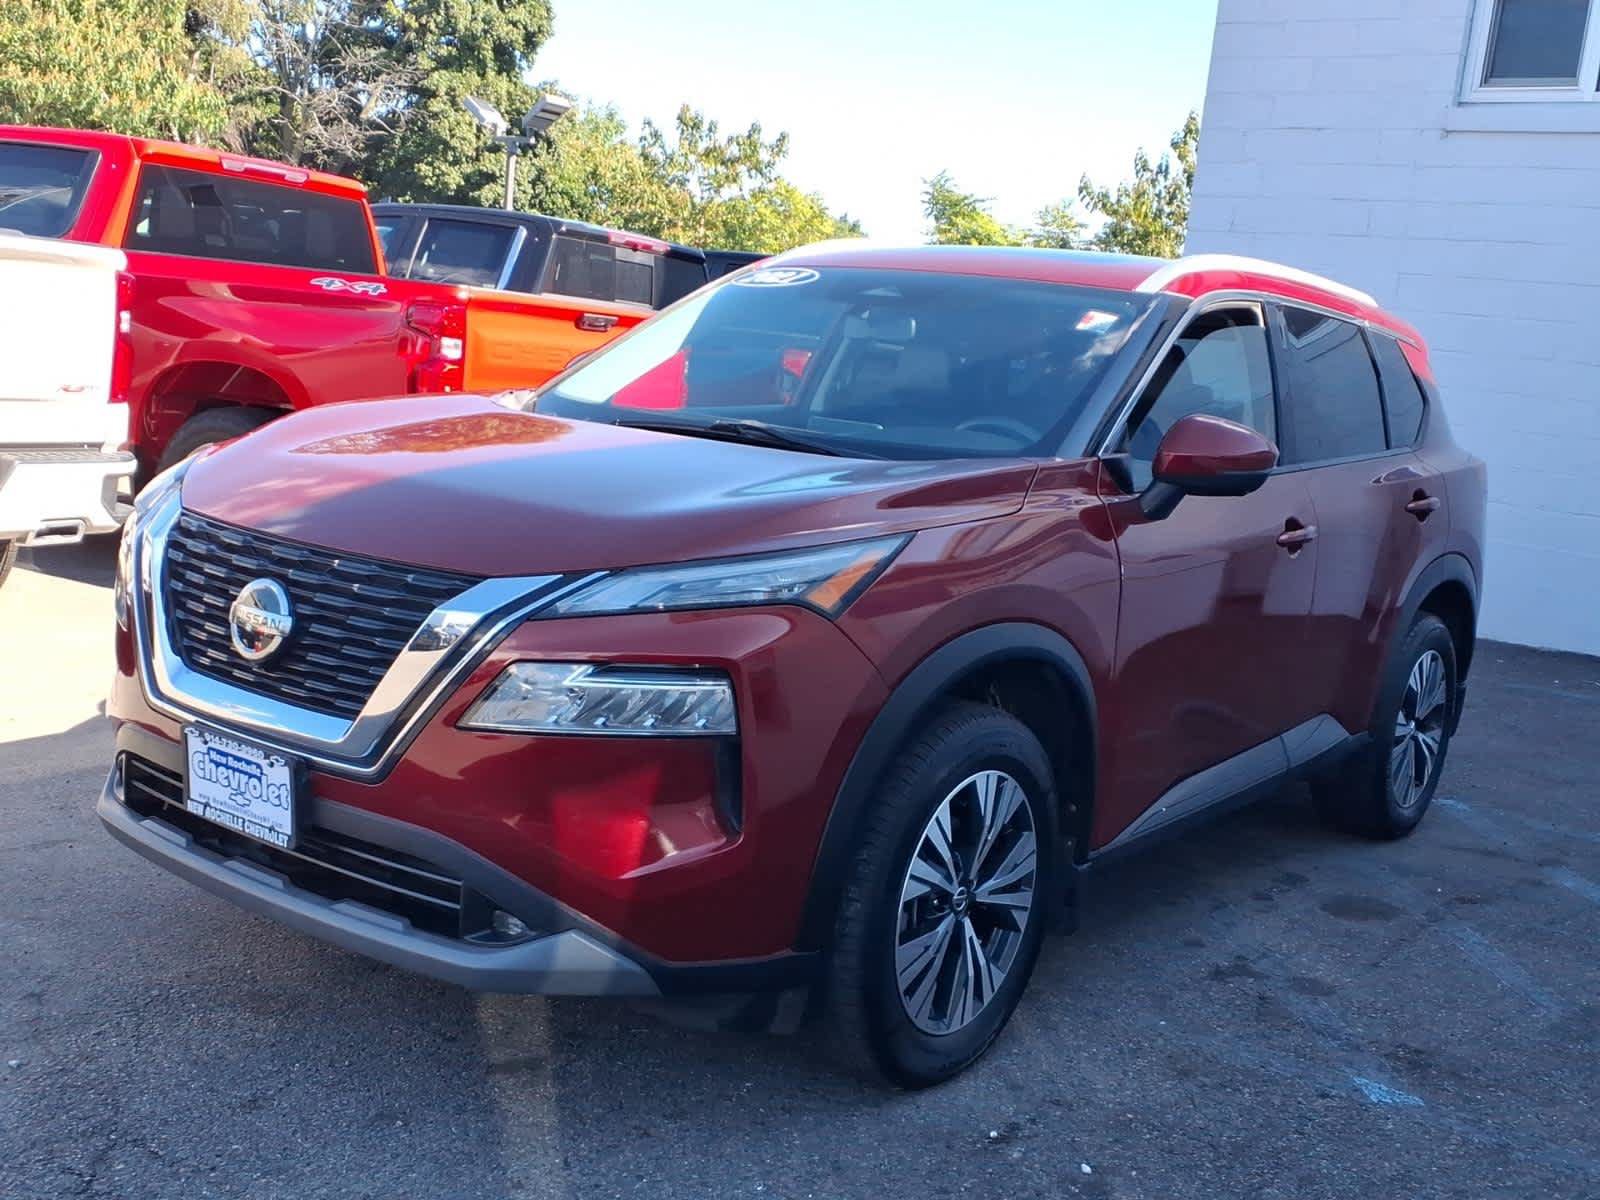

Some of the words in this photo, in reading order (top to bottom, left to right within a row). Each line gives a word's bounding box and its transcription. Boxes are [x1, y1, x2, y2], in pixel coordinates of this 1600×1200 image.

[191, 750, 289, 811] Chevrolet
[209, 749, 227, 764] New
[227, 755, 262, 776] Rochelle
[187, 799, 204, 816] NEW
[205, 804, 244, 831] ROCHELLE
[244, 818, 289, 848] CHEVROLET
